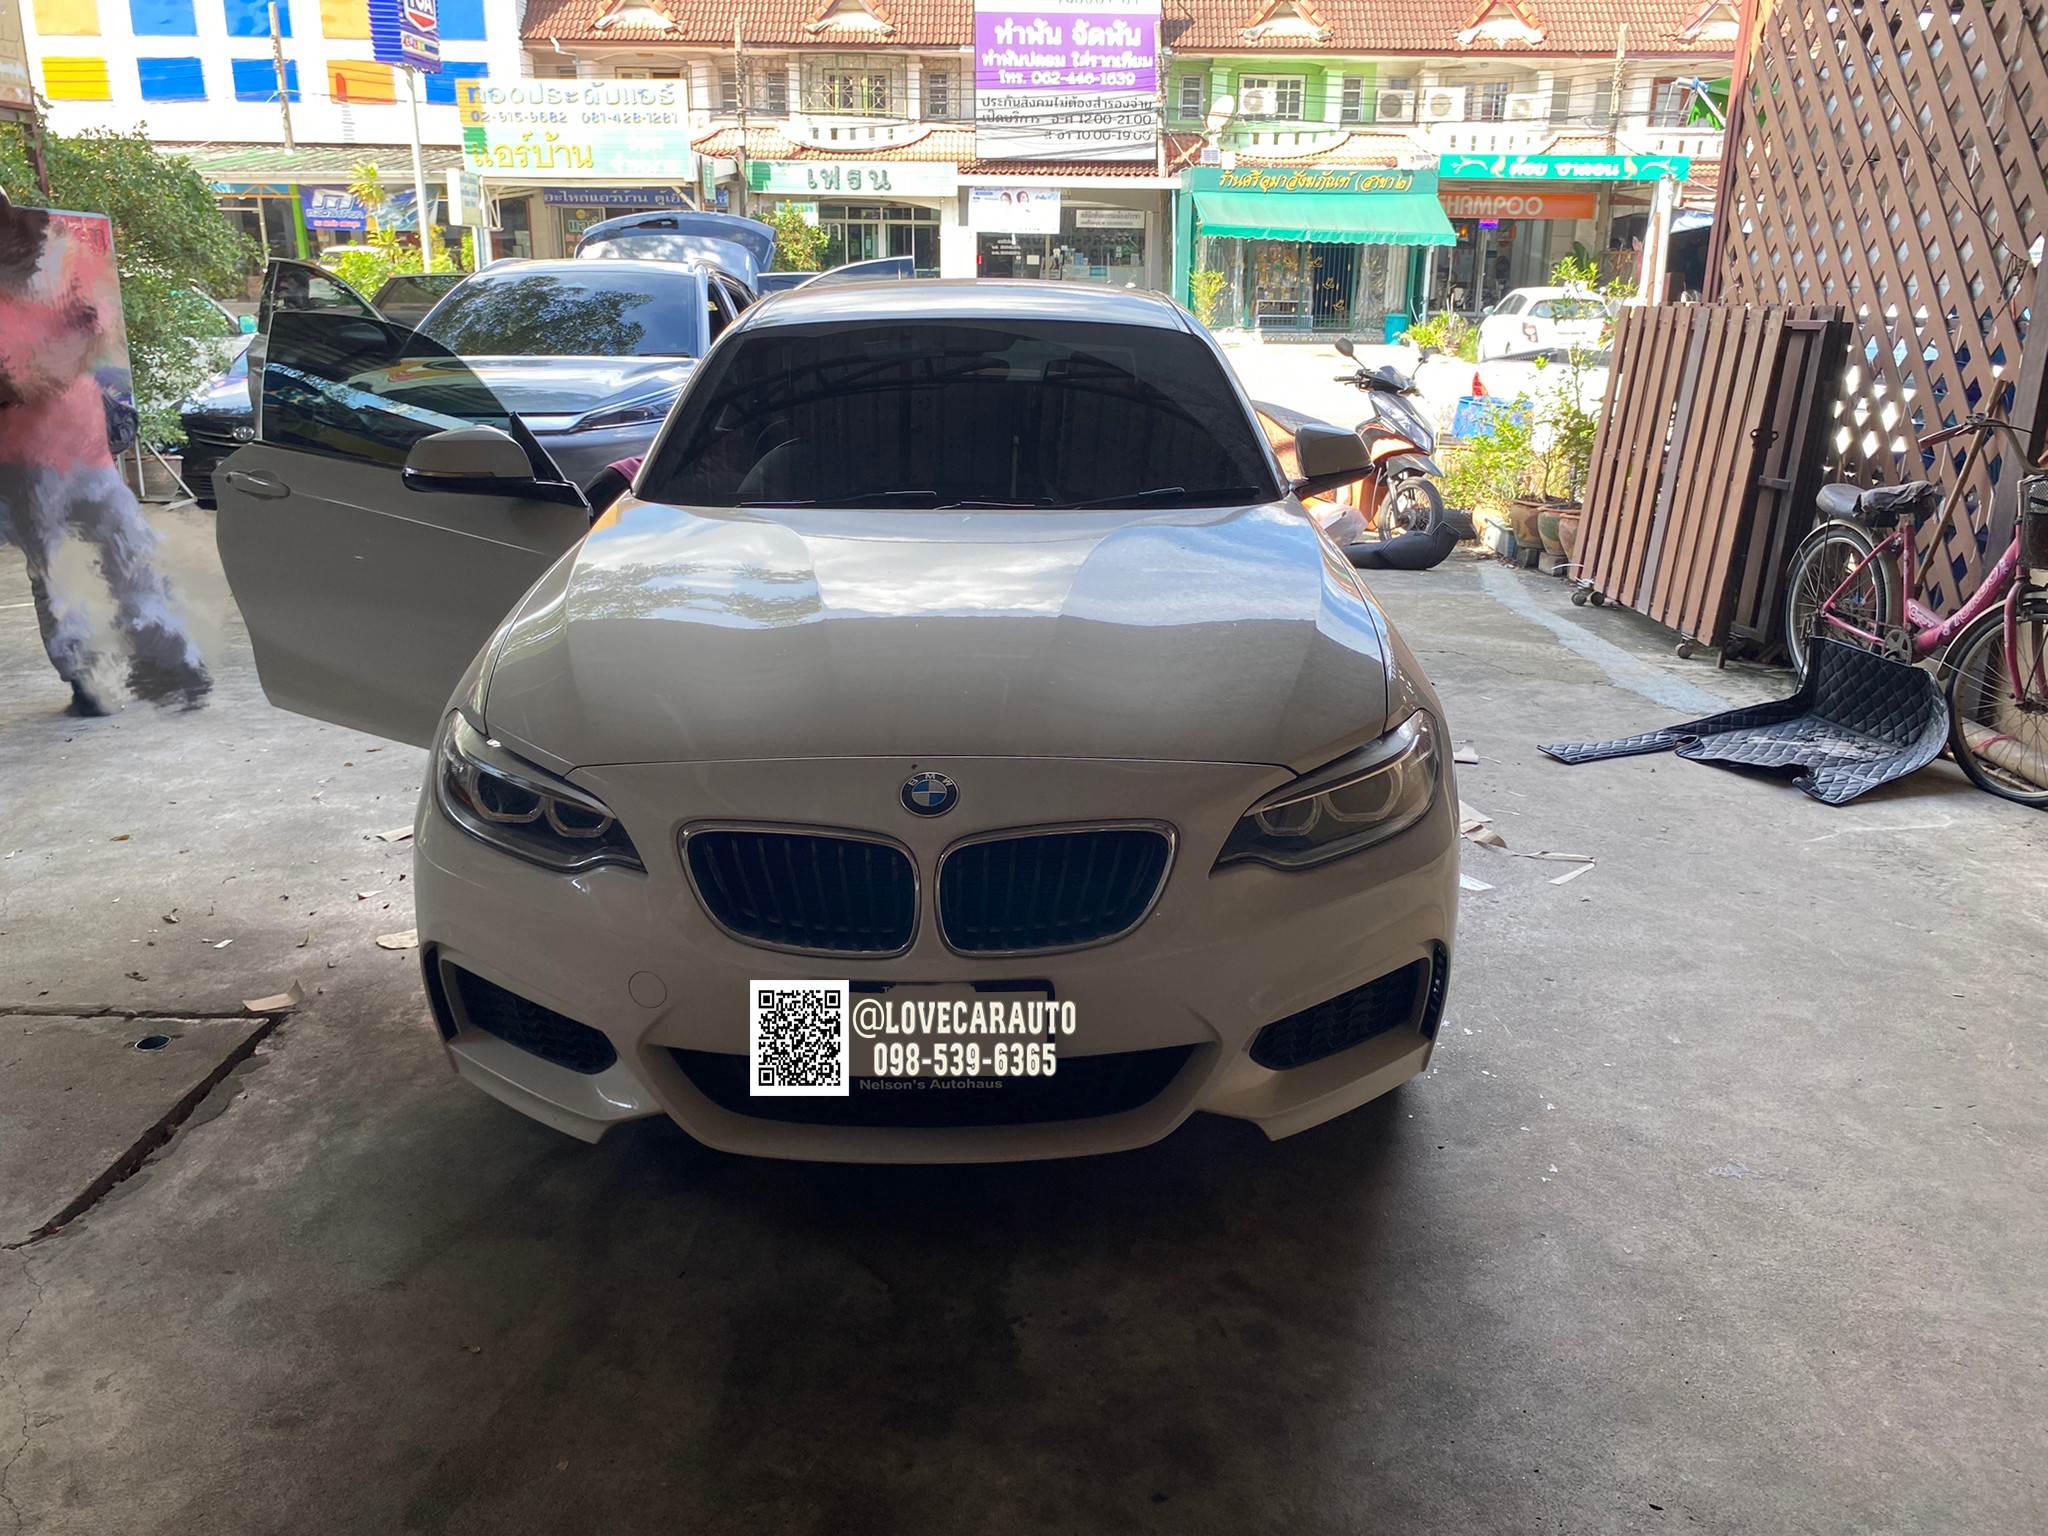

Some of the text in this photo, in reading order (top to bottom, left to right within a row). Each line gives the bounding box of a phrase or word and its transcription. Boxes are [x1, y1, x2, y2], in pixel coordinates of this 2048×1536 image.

[994, 17, 1142, 47] ทำฟัน จัดฟัน
[982, 48, 1153, 68] ทำฟันปลอม ใส่รากเทียม
[998, 69, 1027, 84] โทร.
[472, 131, 594, 168] แอร์บ้าน
[544, 189, 648, 203] อะไหล่แอร์บ้าน
[859, 1079, 1003, 1091] Nelson's Autohaus
